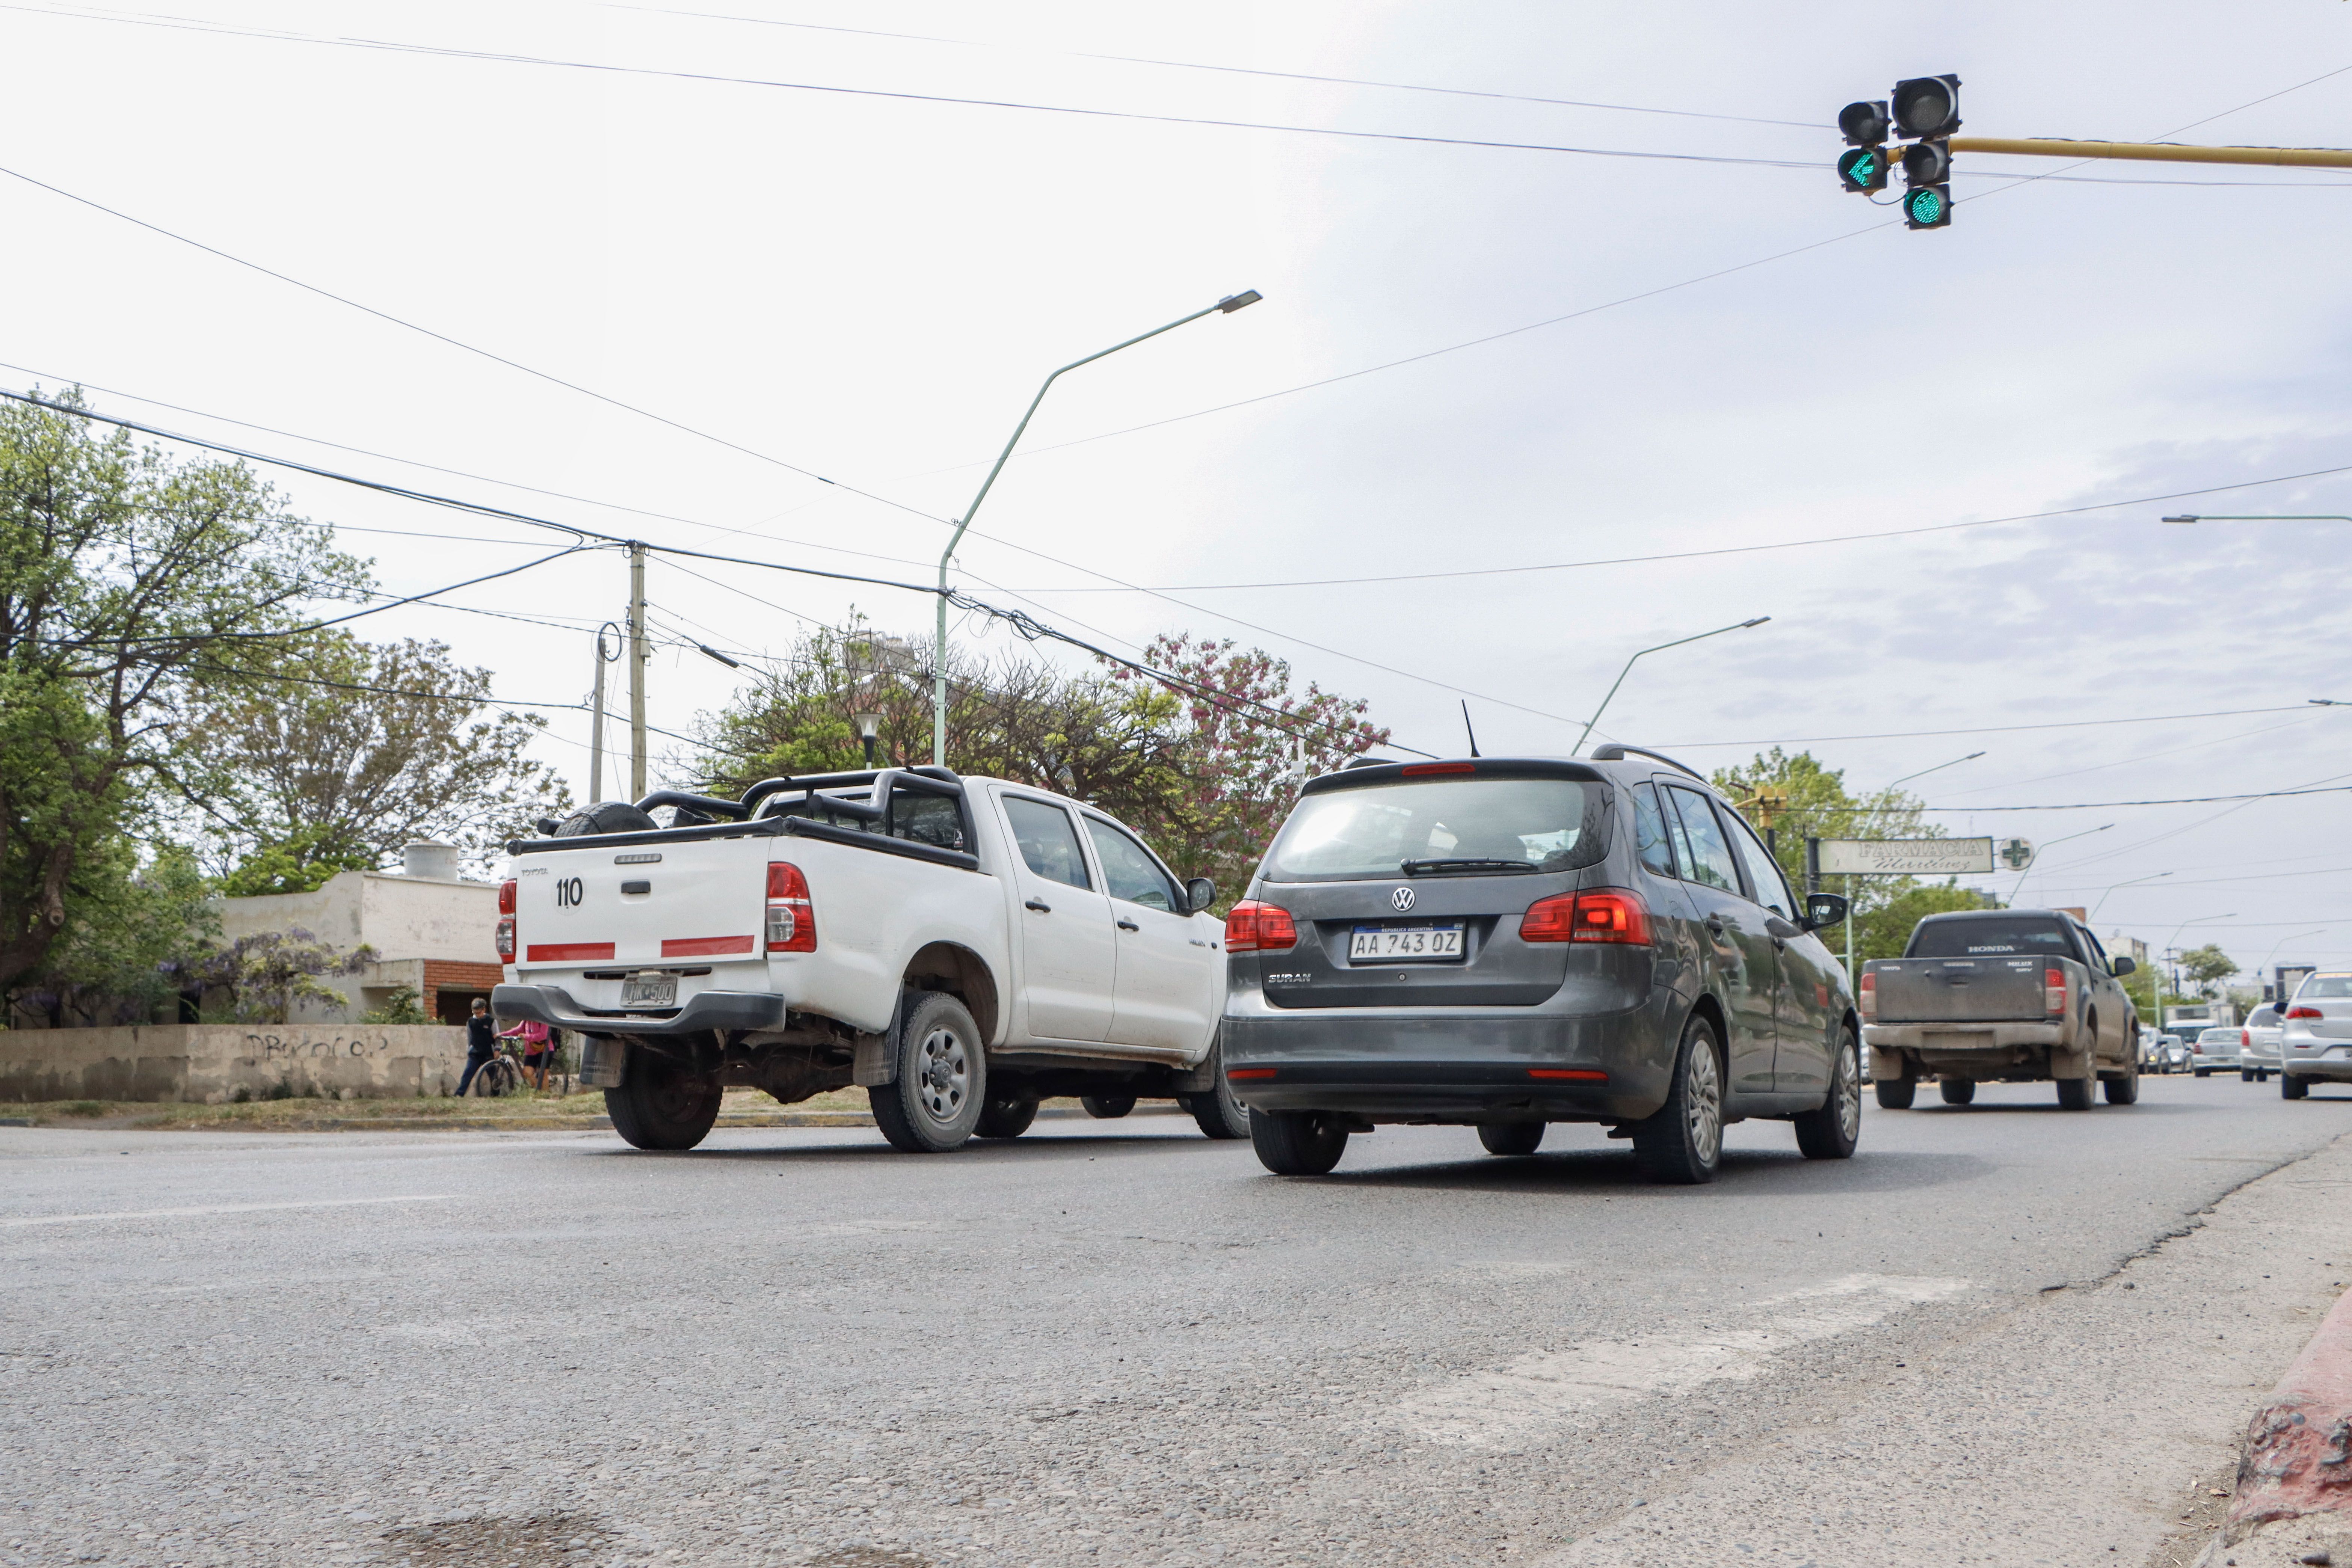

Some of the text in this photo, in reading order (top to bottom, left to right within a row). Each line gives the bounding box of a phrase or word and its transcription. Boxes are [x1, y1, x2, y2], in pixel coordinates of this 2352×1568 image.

[1859, 839, 1983, 857] FARMACIA
[521, 868, 548, 876] TOYOTA
[556, 877, 583, 906] 110
[1355, 935, 1378, 954] AA
[1387, 934, 1424, 953] 743
[1268, 973, 1311, 983] SURAN
[650, 984, 673, 1000] 500
